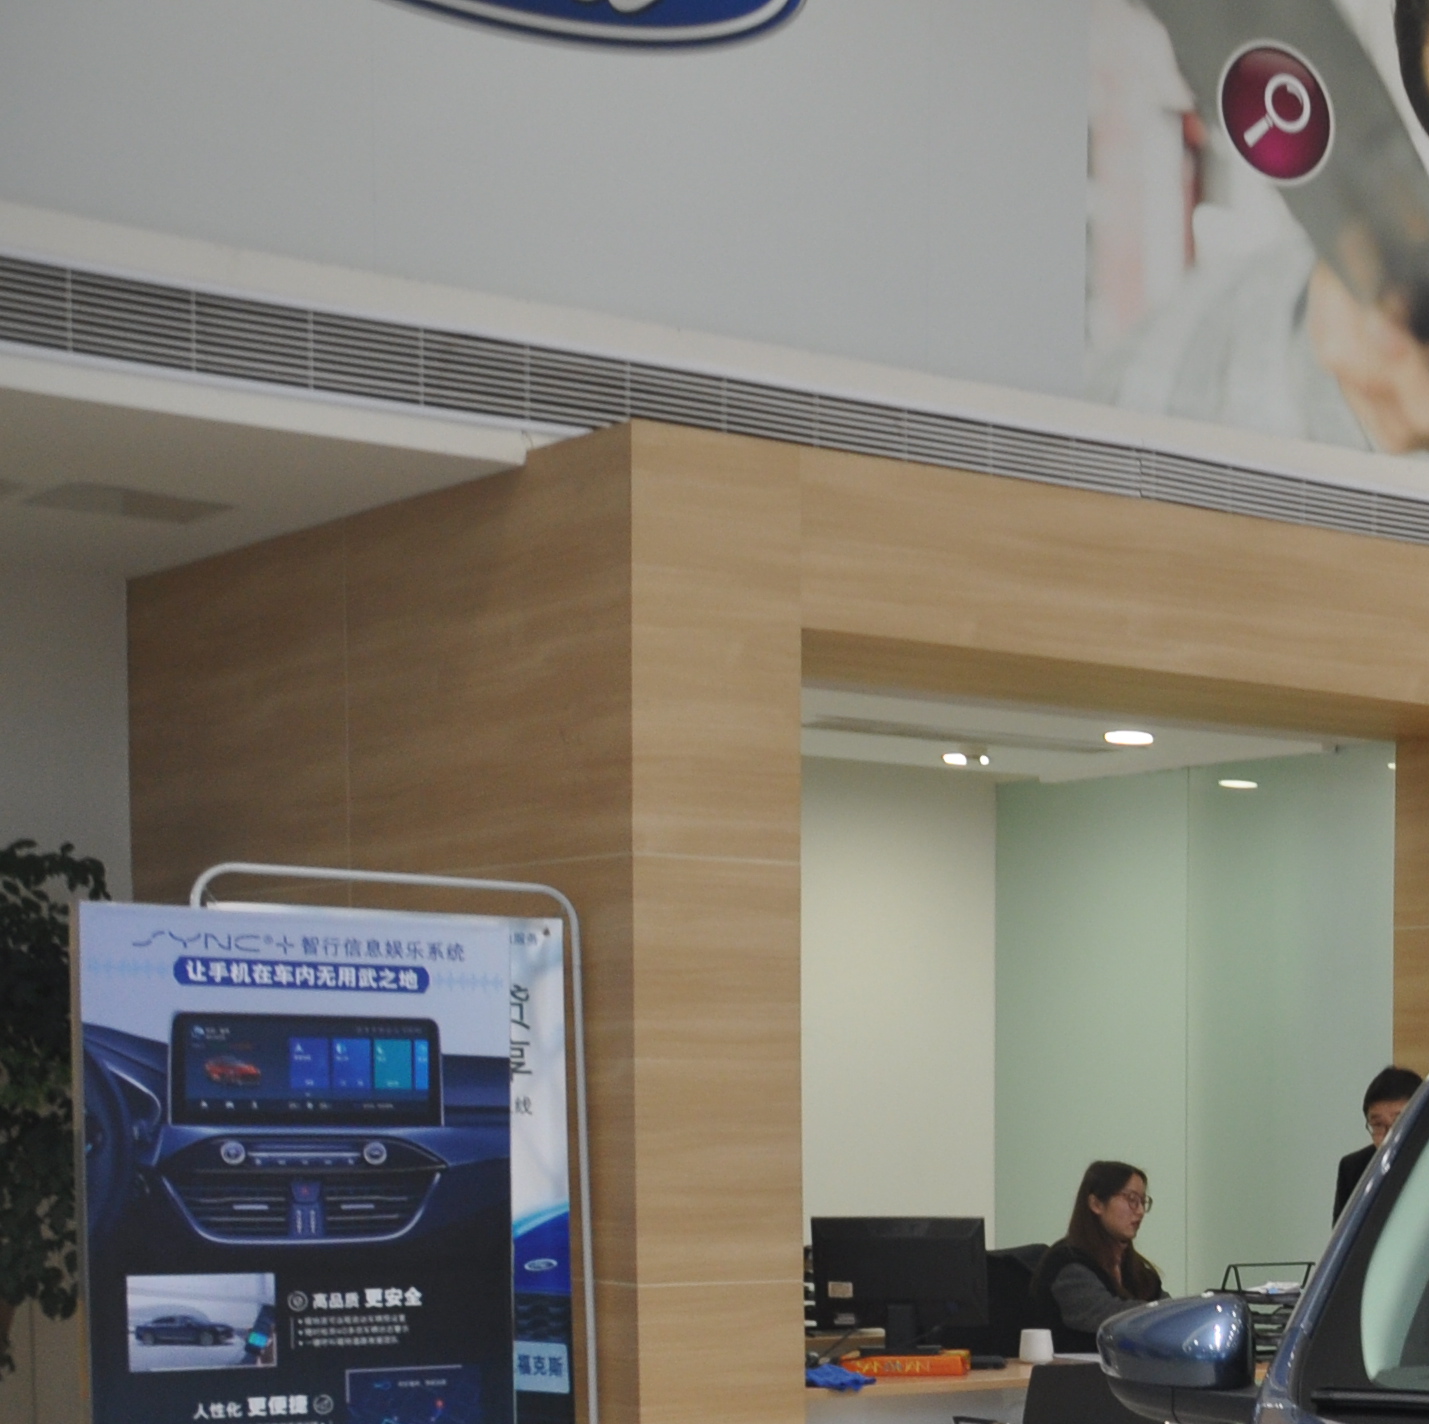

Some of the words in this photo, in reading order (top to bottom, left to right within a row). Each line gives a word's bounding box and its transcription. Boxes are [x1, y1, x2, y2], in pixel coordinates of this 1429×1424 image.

[185, 959, 419, 990] 让手机在车内无用武之地
[364, 1286, 423, 1308] 更安全
[193, 1402, 243, 1420] 人性化
